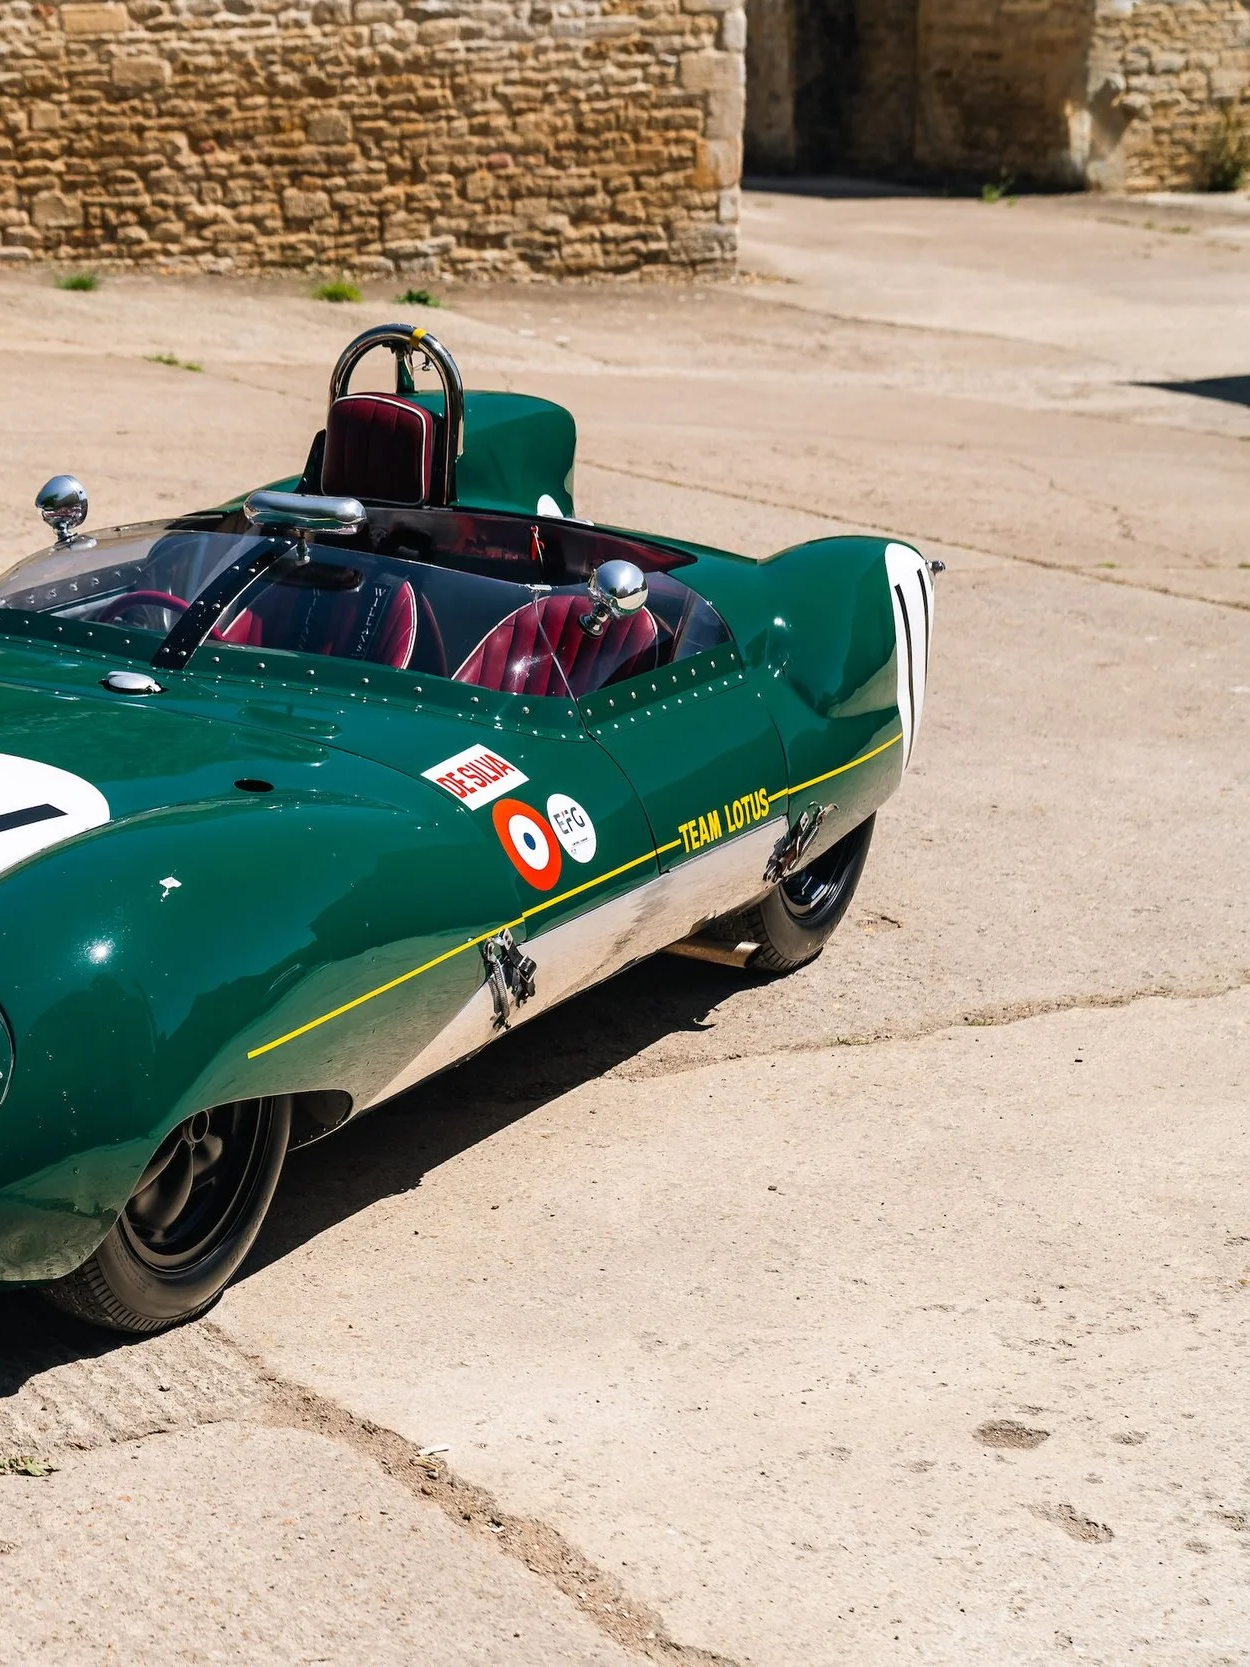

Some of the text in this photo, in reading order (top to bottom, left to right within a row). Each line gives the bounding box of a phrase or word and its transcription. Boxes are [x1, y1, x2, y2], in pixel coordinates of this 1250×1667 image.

[894, 568, 929, 769] 11
[436, 753, 516, 799] DE SILVA
[553, 806, 586, 835] EFG
[678, 787, 771, 853] TEAM LOTUS
